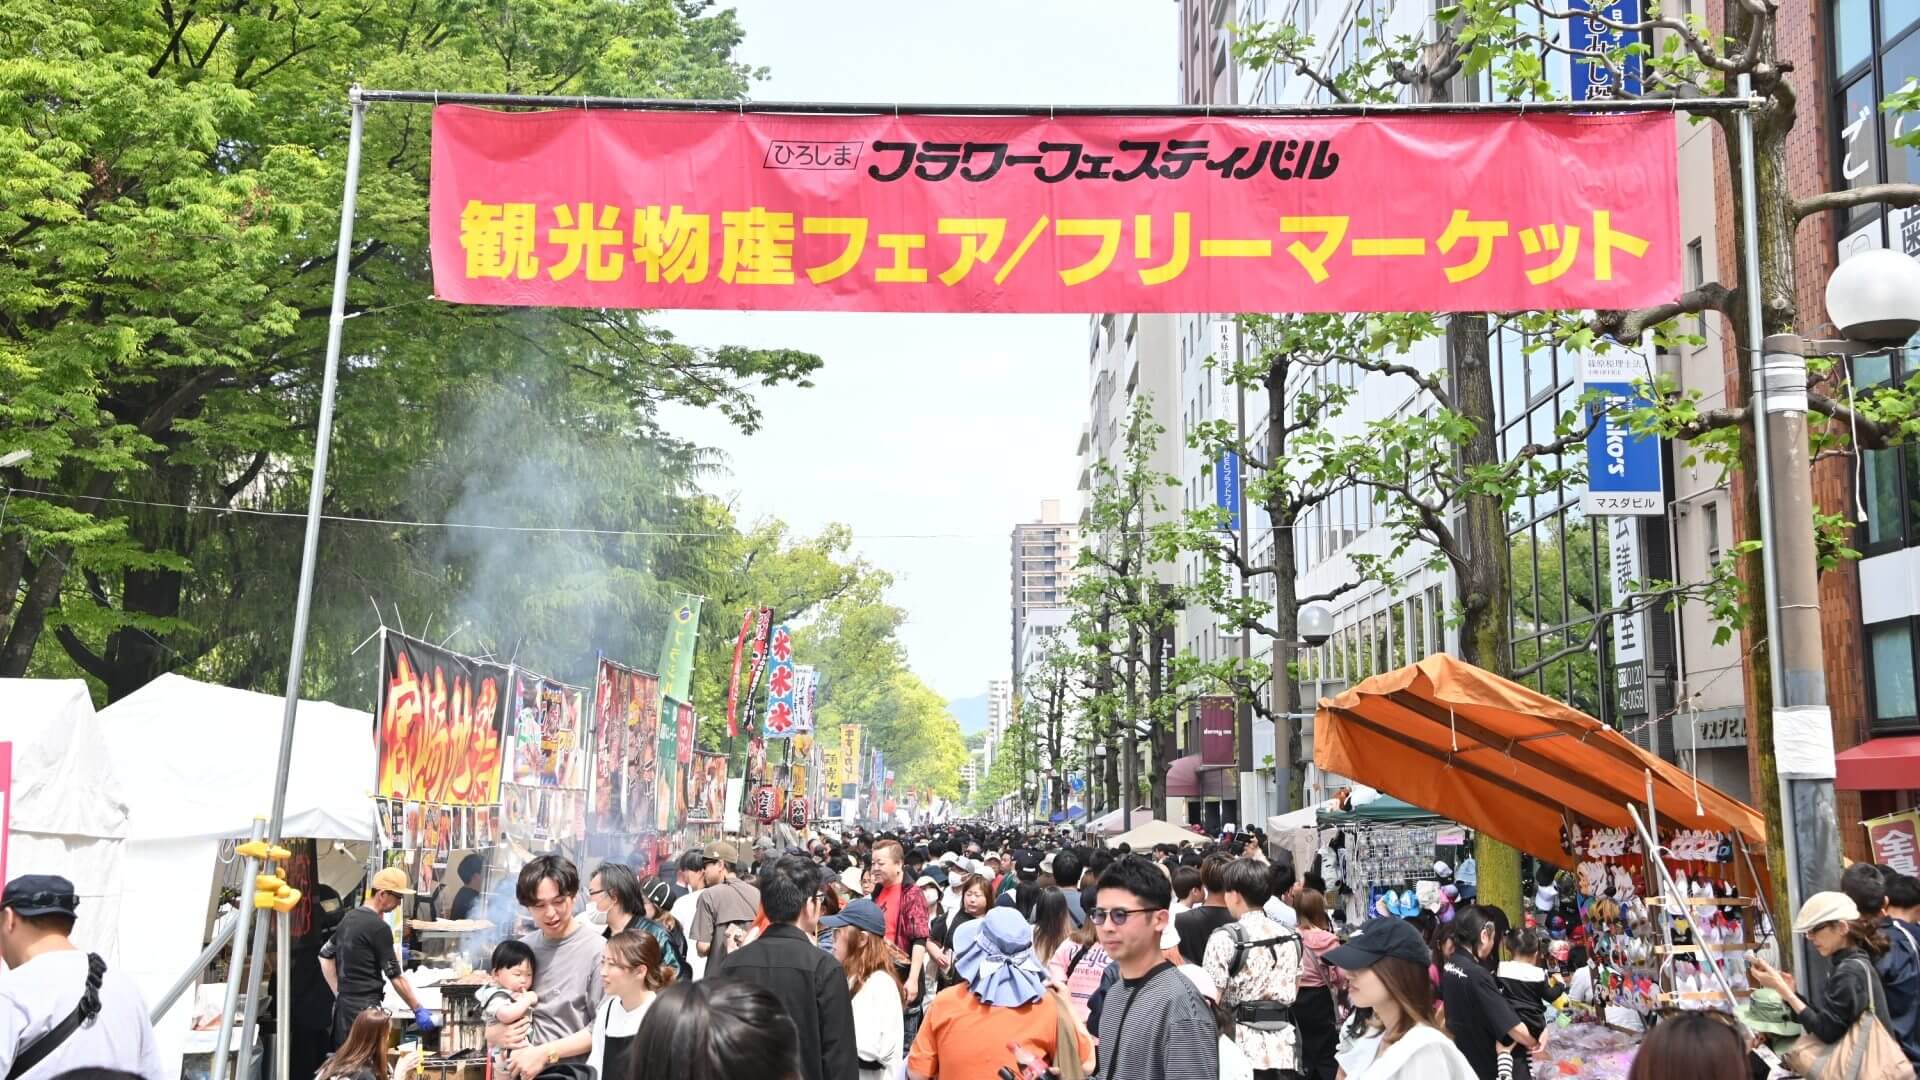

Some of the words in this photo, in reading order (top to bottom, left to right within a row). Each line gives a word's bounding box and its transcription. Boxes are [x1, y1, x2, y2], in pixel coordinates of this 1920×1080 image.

[774, 143, 852, 168] ひろしま
[868, 138, 1340, 183] フラワーフェスティバル
[459, 200, 1651, 287] 観光物産フェア/フリーマーケット
[1595, 497, 1656, 509] マスダビル
[1626, 665, 1643, 686] 0120
